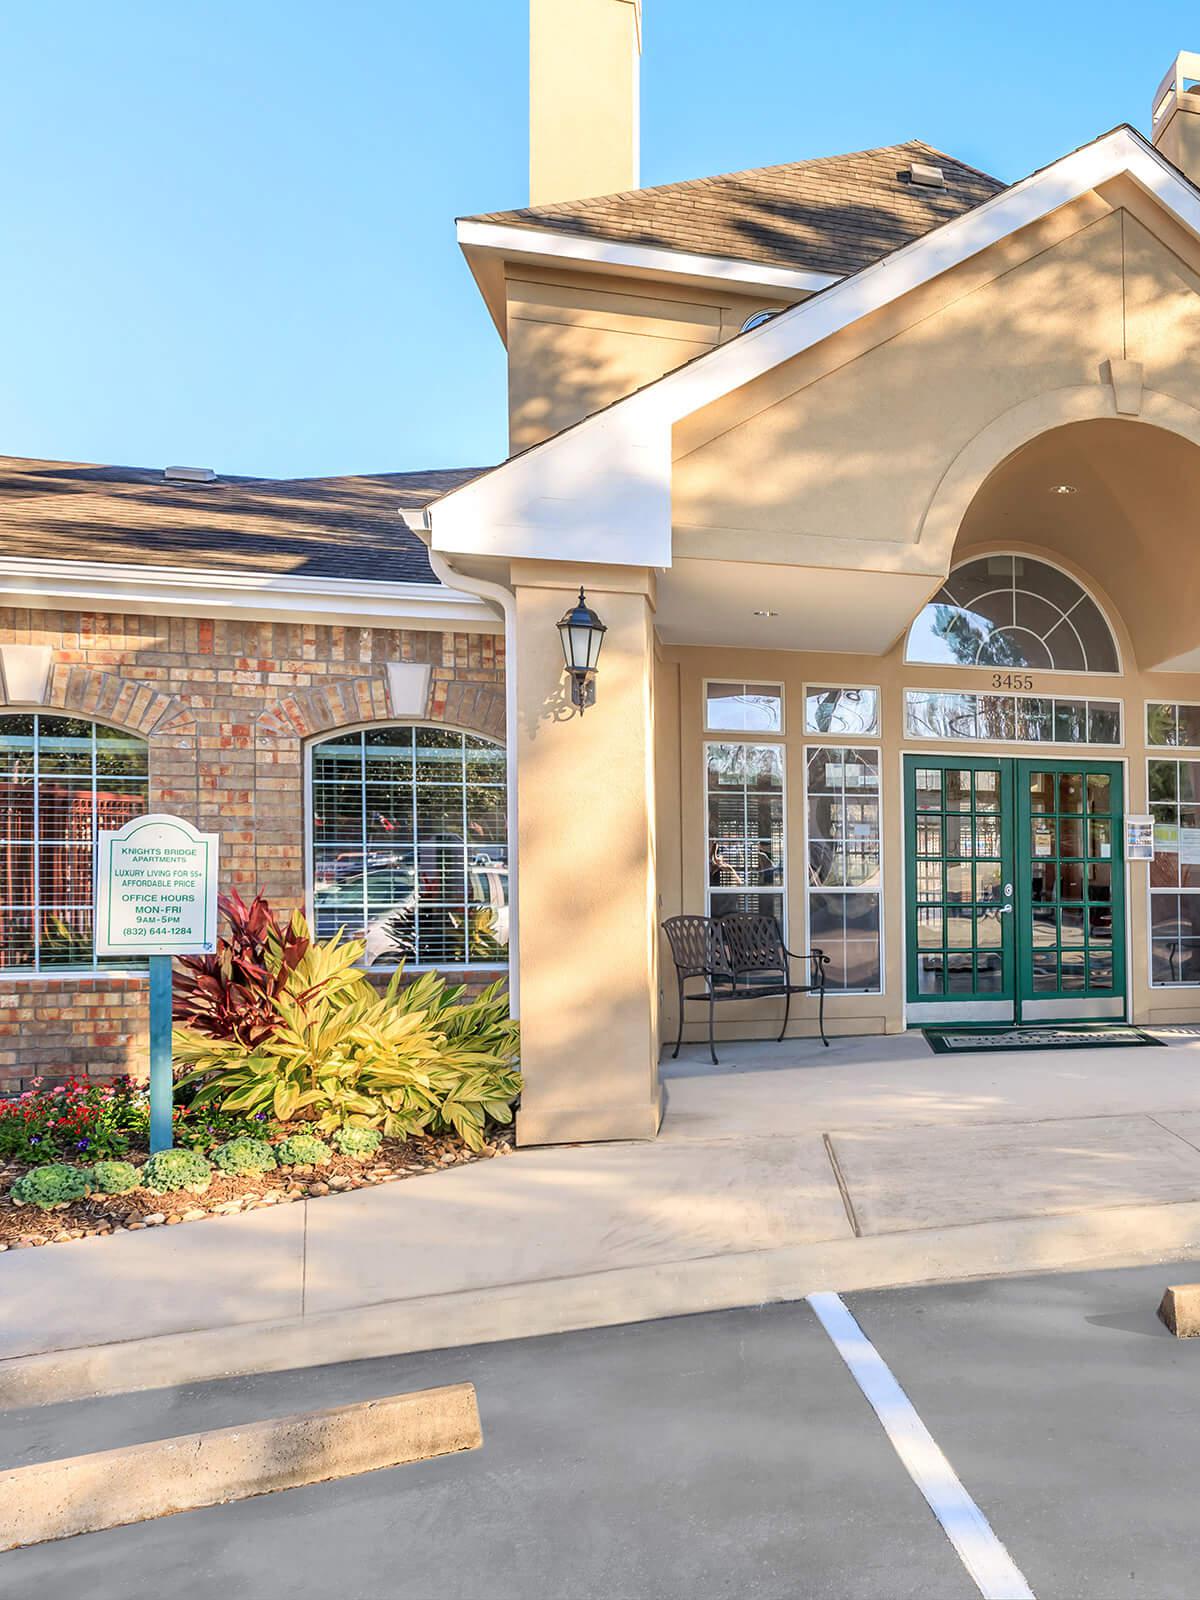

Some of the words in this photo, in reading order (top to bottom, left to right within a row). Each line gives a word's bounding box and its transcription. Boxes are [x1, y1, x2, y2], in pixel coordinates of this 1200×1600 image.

[992, 674, 1033, 690] 3455
[121, 847, 161, 856] KNIGHTS
[164, 848, 197, 856] BRIDGE
[114, 869, 145, 877] LUXURY
[146, 869, 171, 877] LIVING
[173, 869, 188, 877] FOR
[121, 879, 172, 888] AFFORDABLE
[174, 880, 196, 888] PRICE
[121, 894, 157, 902] OFFICE
[160, 894, 195, 902] HOURS
[135, 905, 182, 914] MON-FRI
[123, 927, 147, 937] (832)
[149, 927, 192, 936] 644-1284
